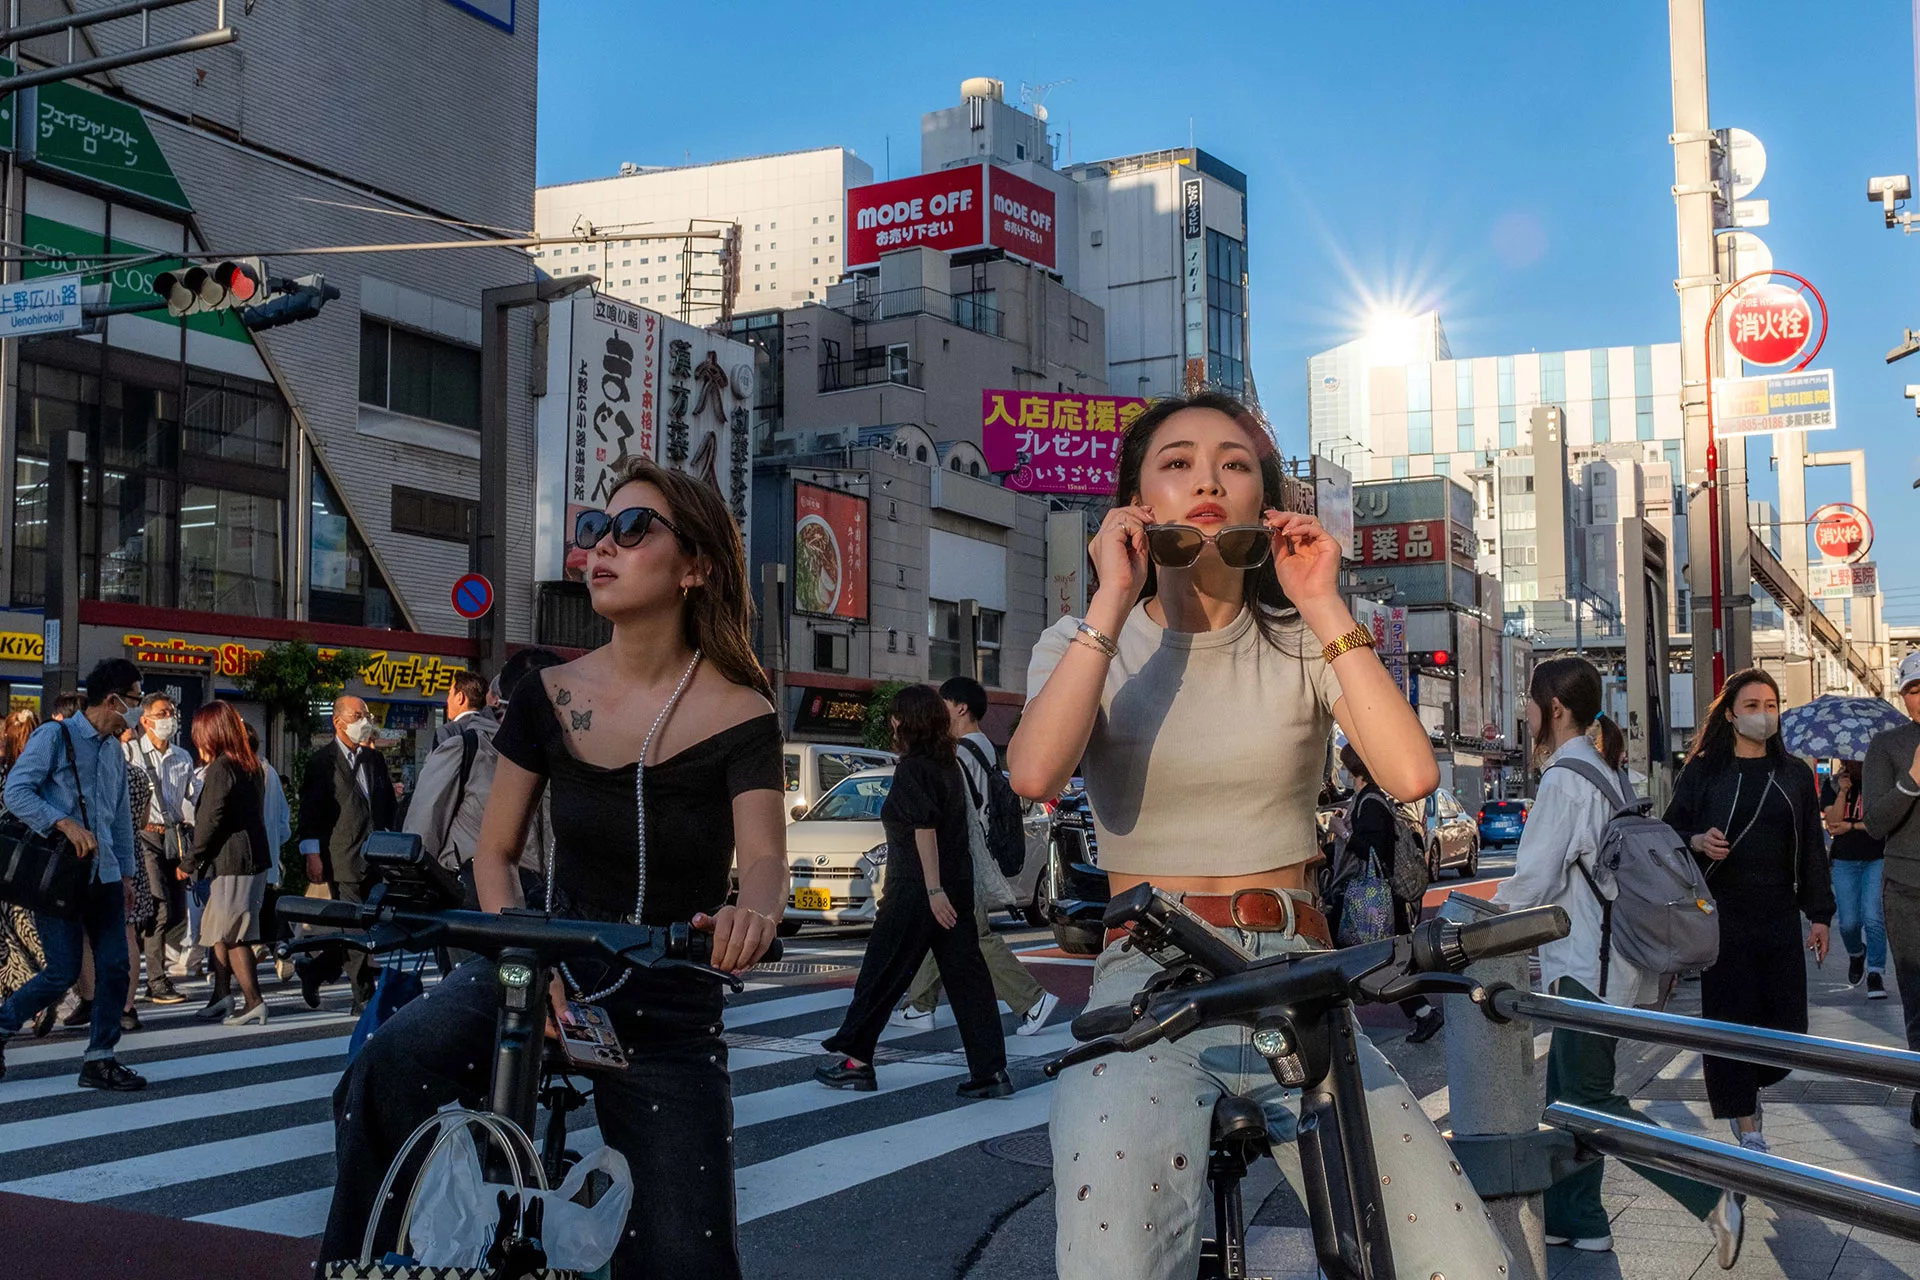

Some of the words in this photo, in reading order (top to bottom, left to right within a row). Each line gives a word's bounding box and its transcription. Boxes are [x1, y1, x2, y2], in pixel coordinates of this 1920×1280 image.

[41, 102, 138, 148] フェイシャリスト
[857, 198, 923, 230] MODE
[929, 189, 973, 216] OFF
[993, 193, 1028, 223] MODE
[1030, 209, 1051, 231] OFF
[876, 220, 954, 246] お売り下さい
[1003, 220, 1043, 245] お売り下さい
[0, 285, 77, 315] 上野広小路
[595, 300, 638, 329] 立喰い鮨
[11, 311, 65, 328] Uenohirokoji
[1735, 307, 1805, 343] 消火栓
[641, 313, 656, 460] サクッと本格江
[668, 339, 692, 475] 漢方薬
[1014, 429, 1120, 459] プレゼント!
[1820, 524, 1859, 546] 消火栓
[1827, 566, 1875, 587] 上野医院
